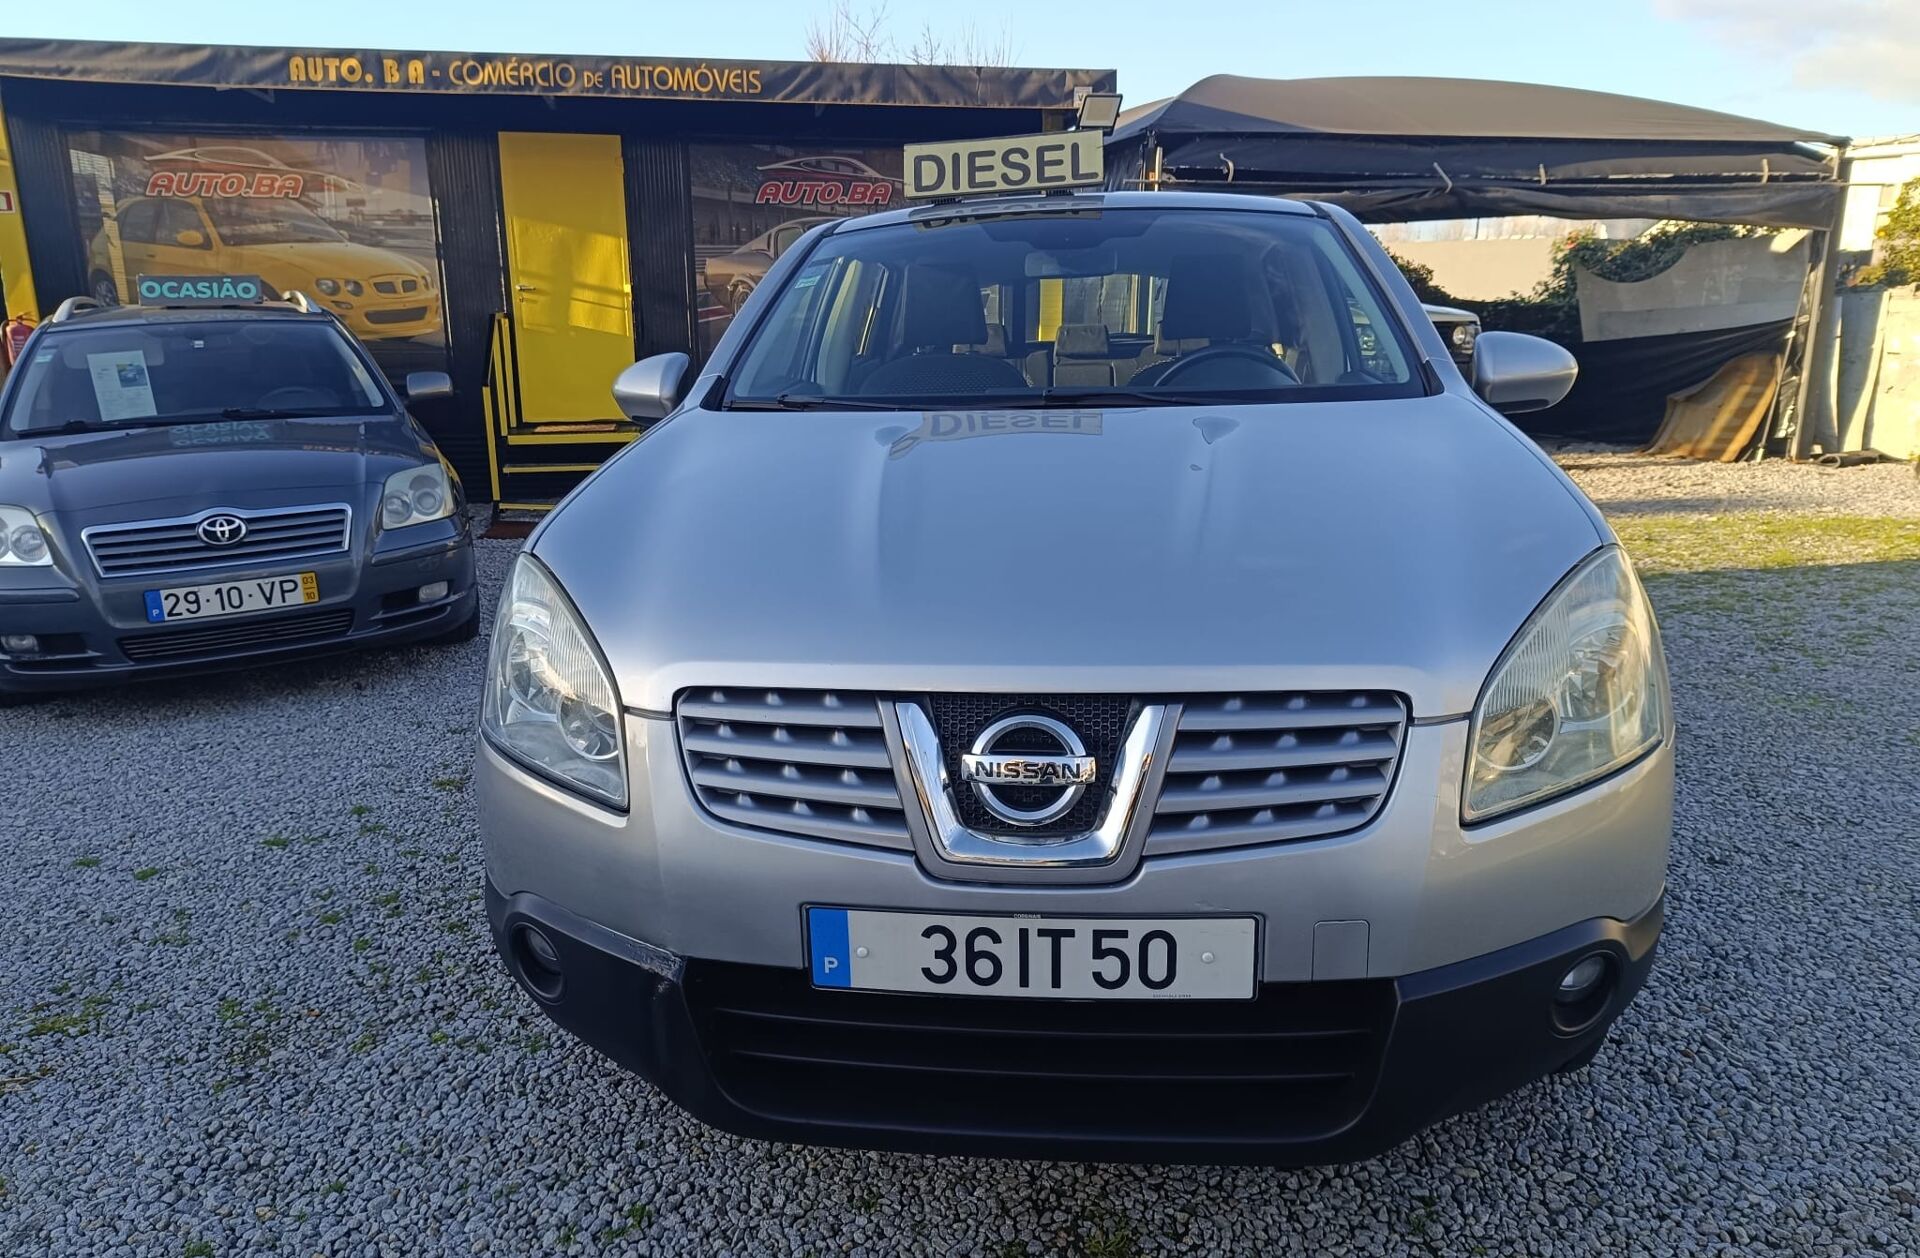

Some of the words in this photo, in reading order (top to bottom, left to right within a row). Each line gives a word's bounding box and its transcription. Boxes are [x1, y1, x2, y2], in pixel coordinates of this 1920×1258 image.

[449, 57, 576, 89] COMÉRCIO
[584, 71, 604, 89] DE
[611, 63, 762, 94] AUTOMÓVEIS
[914, 142, 1099, 192] DIESEL
[146, 172, 303, 198] AUTO.BA
[755, 181, 892, 205] AUTO.BA
[140, 278, 257, 299] OCASIÃO
[302, 576, 314, 585] 03
[305, 592, 316, 600] 10
[152, 609, 160, 617] P
[975, 761, 1081, 780] NISSAN
[824, 956, 838, 974] P
